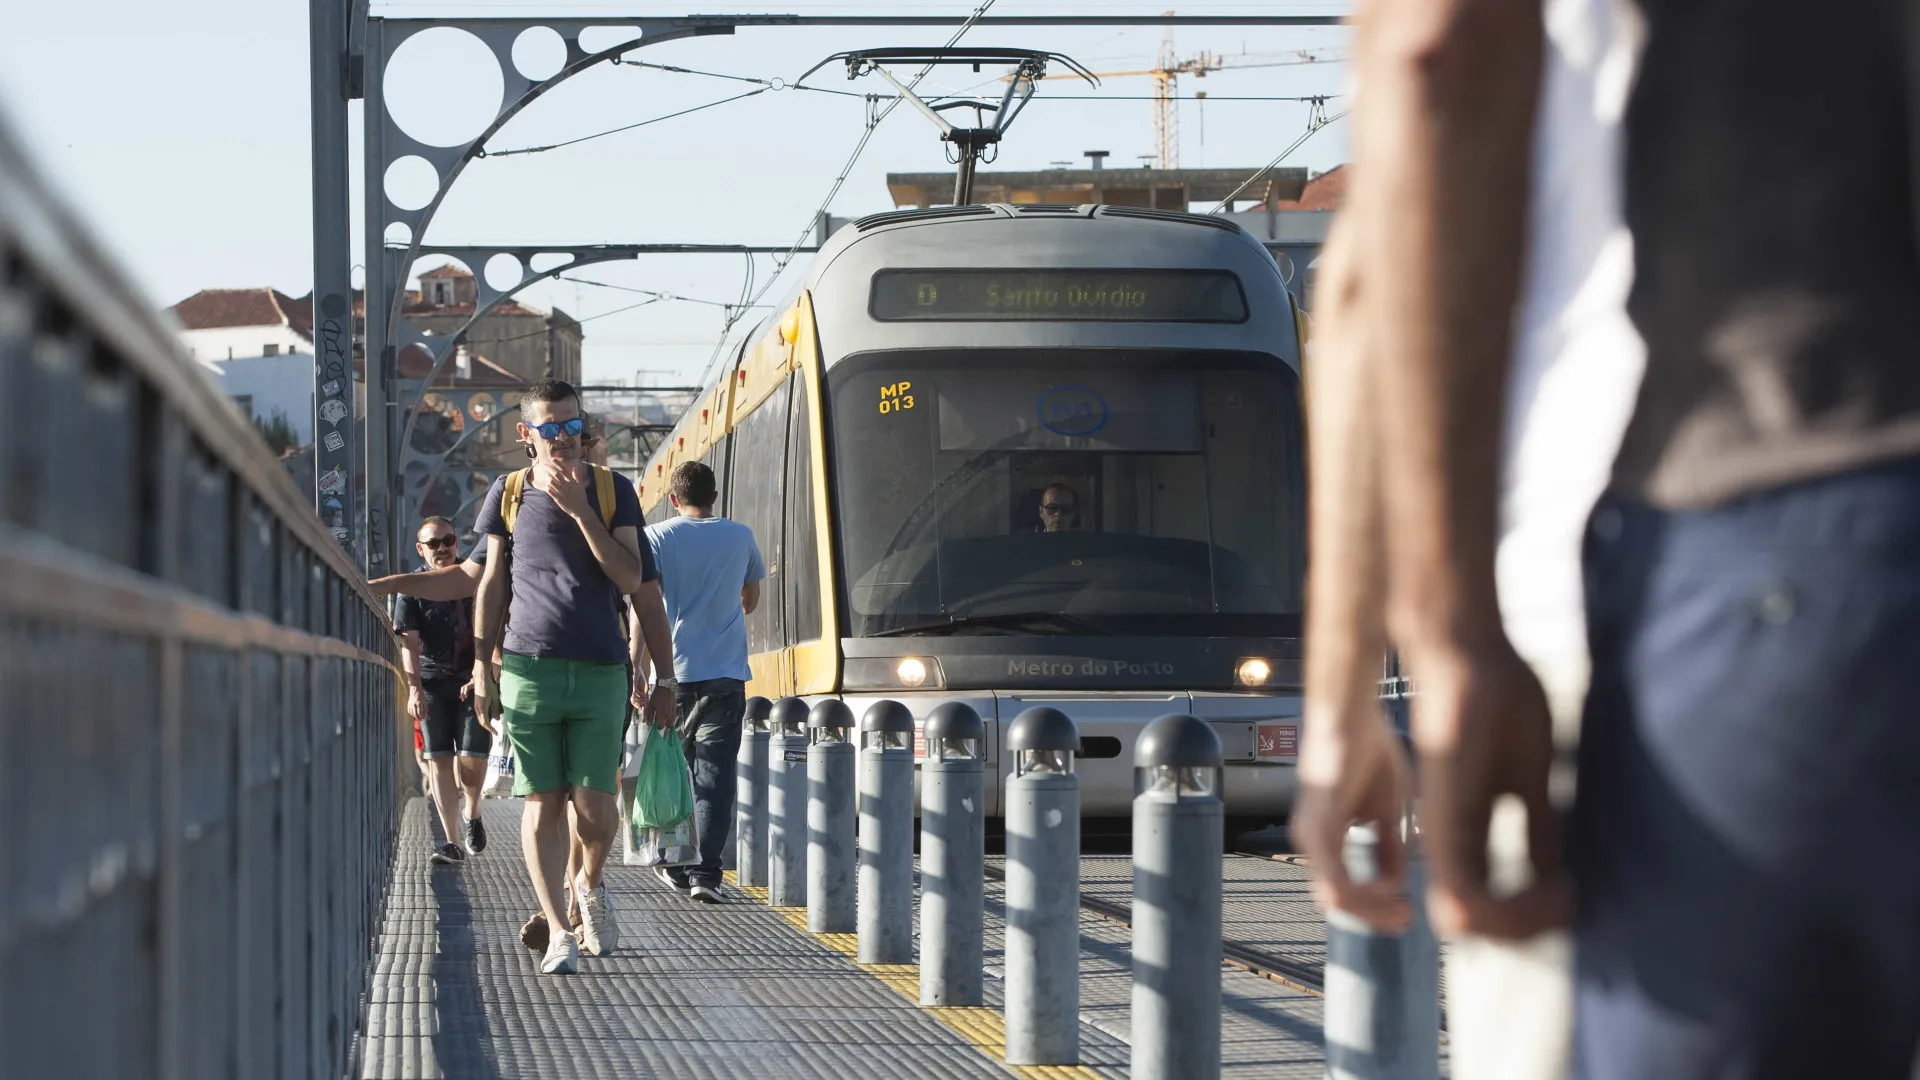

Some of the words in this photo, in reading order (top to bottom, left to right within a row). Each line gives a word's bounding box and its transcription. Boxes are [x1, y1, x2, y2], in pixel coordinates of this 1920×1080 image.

[918, 284, 937, 306] D
[986, 284, 1058, 307] Santo
[881, 381, 911, 400] MP
[879, 395, 914, 414] 013
[1007, 659, 1074, 676] Metro
[1081, 660, 1108, 676] do
[1113, 660, 1174, 676] Porto
